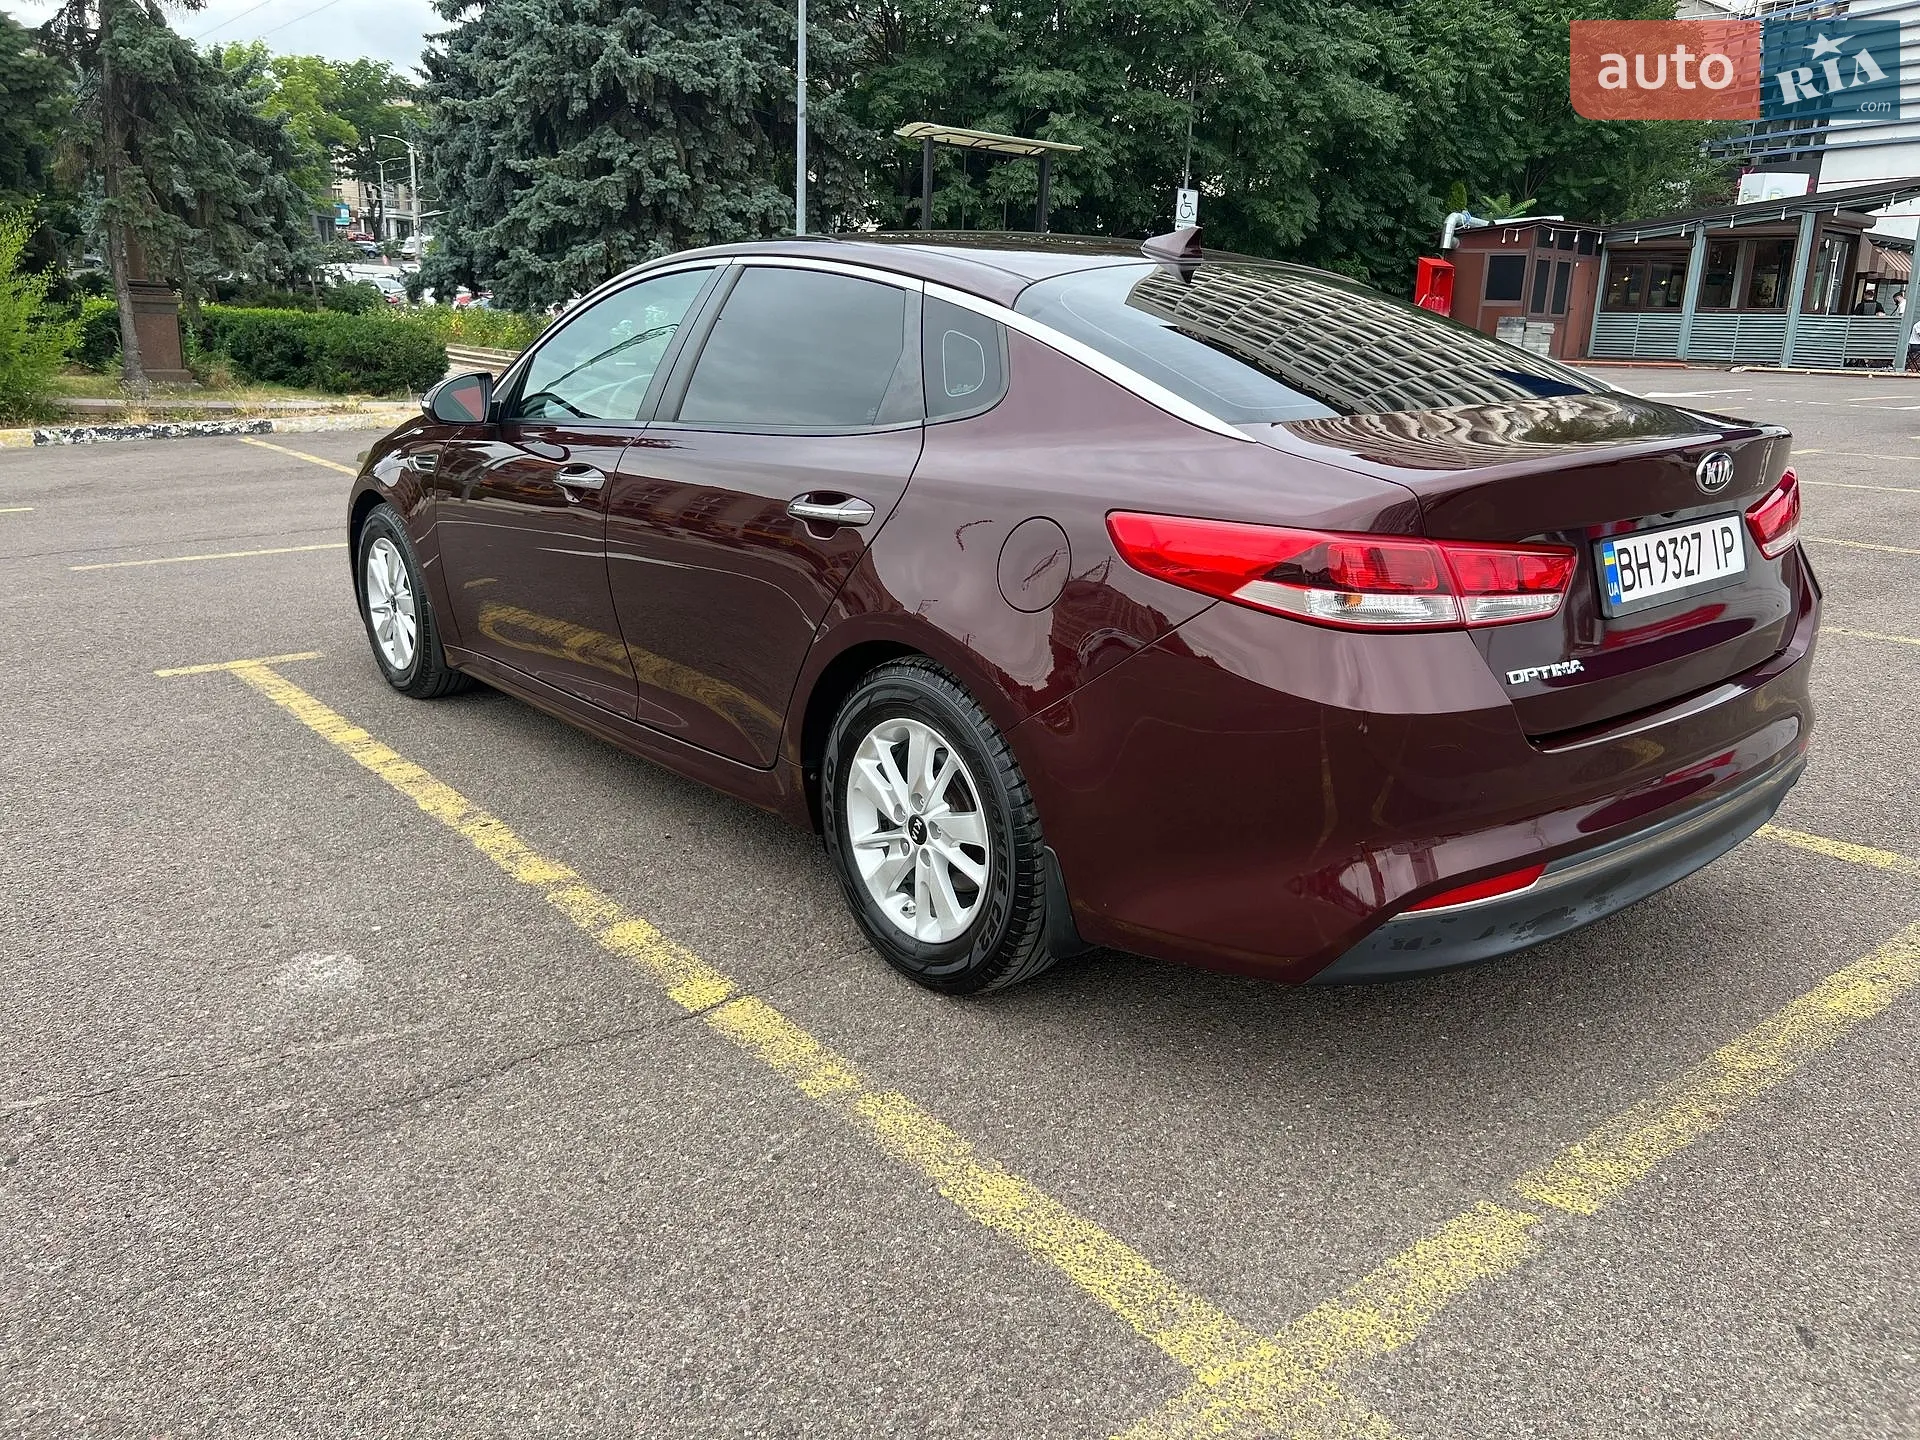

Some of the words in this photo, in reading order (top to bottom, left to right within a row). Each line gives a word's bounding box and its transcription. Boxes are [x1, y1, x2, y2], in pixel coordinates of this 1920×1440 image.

[1704, 461, 1731, 485] KIA
[1616, 543, 1654, 593] BH
[1656, 532, 1702, 583] 9327
[1712, 525, 1735, 570] IP
[1608, 581, 1620, 597] UA
[1506, 659, 1585, 685] OPTIMA
[911, 819, 923, 840] KIA
[977, 758, 1008, 897] PROXES
[979, 901, 1003, 951] CF2
